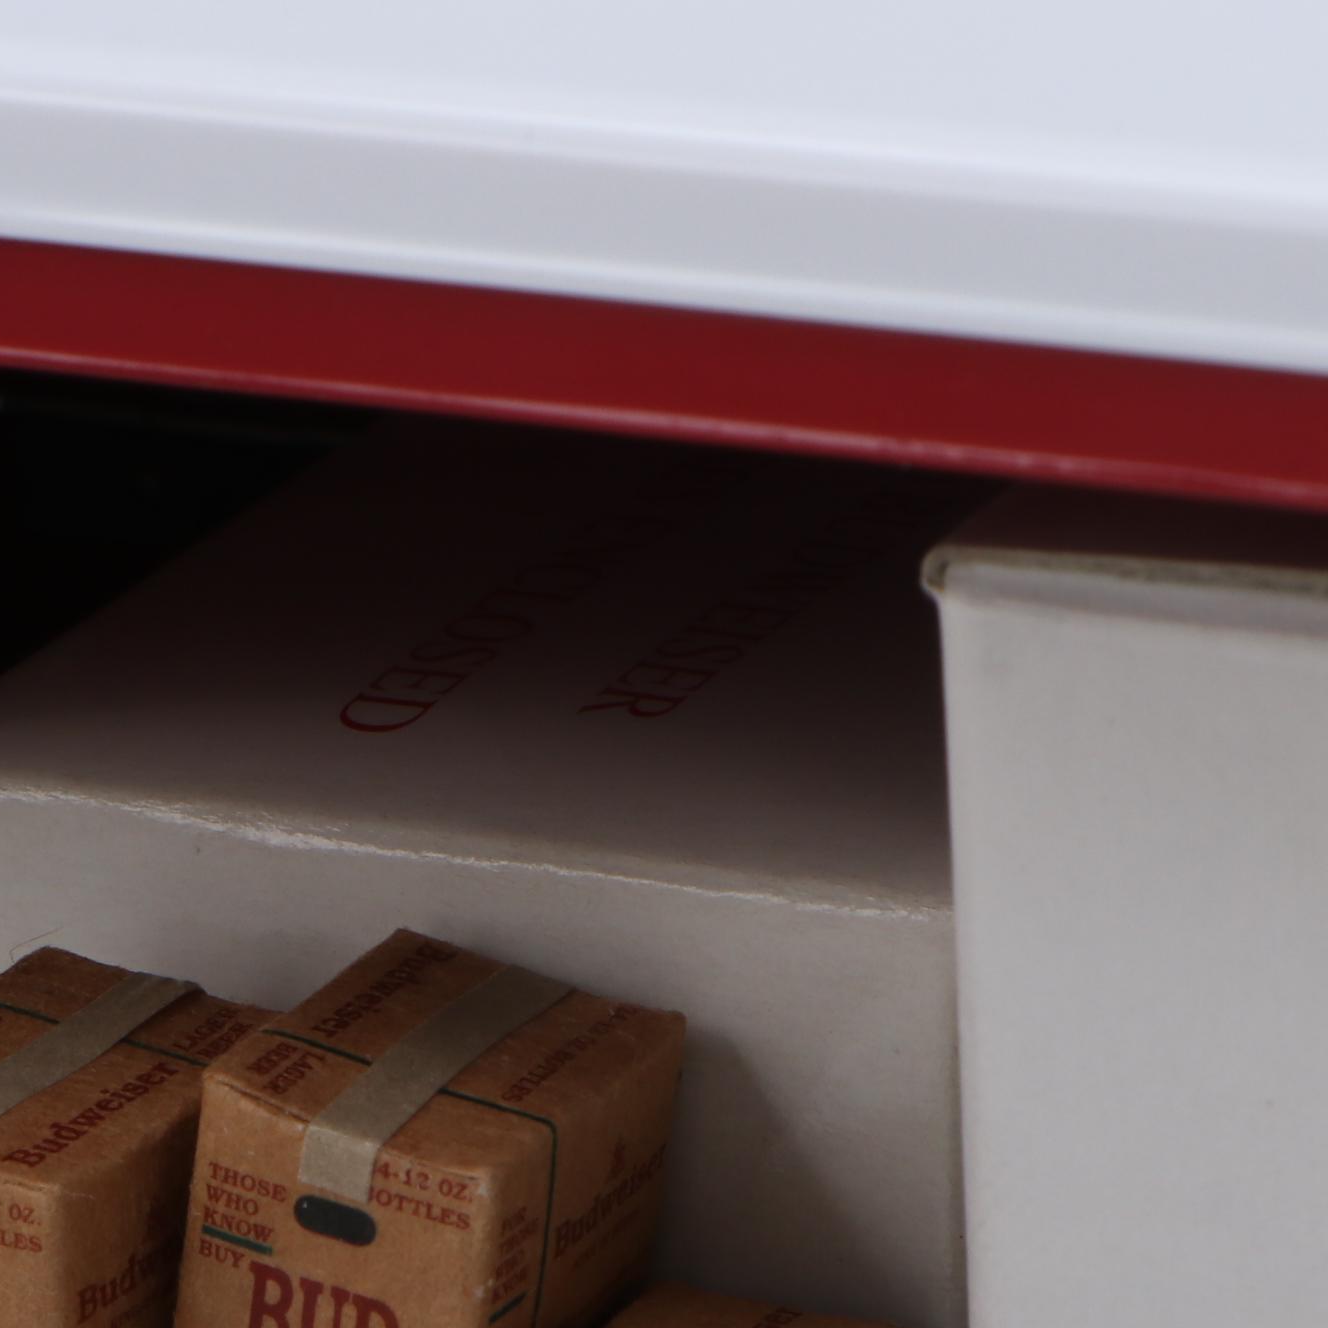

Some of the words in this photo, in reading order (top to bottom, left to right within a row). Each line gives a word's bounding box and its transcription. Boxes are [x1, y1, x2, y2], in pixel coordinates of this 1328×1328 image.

[312, 940, 458, 1040] Budweiser
[264, 1049, 326, 1095] LAGER
[1, 1058, 180, 1169] Budweiser
[209, 1162, 287, 1203] THOSE
[374, 1161, 431, 1192] 4-12
[8, 1204, 43, 1227] OZ.
[206, 1185, 259, 1217] WHO
[368, 1186, 471, 1231] OTTLES
[554, 1141, 667, 1259] Budweiser
[203, 1207, 273, 1244] KNOW
[198, 1238, 246, 1269] BUY
